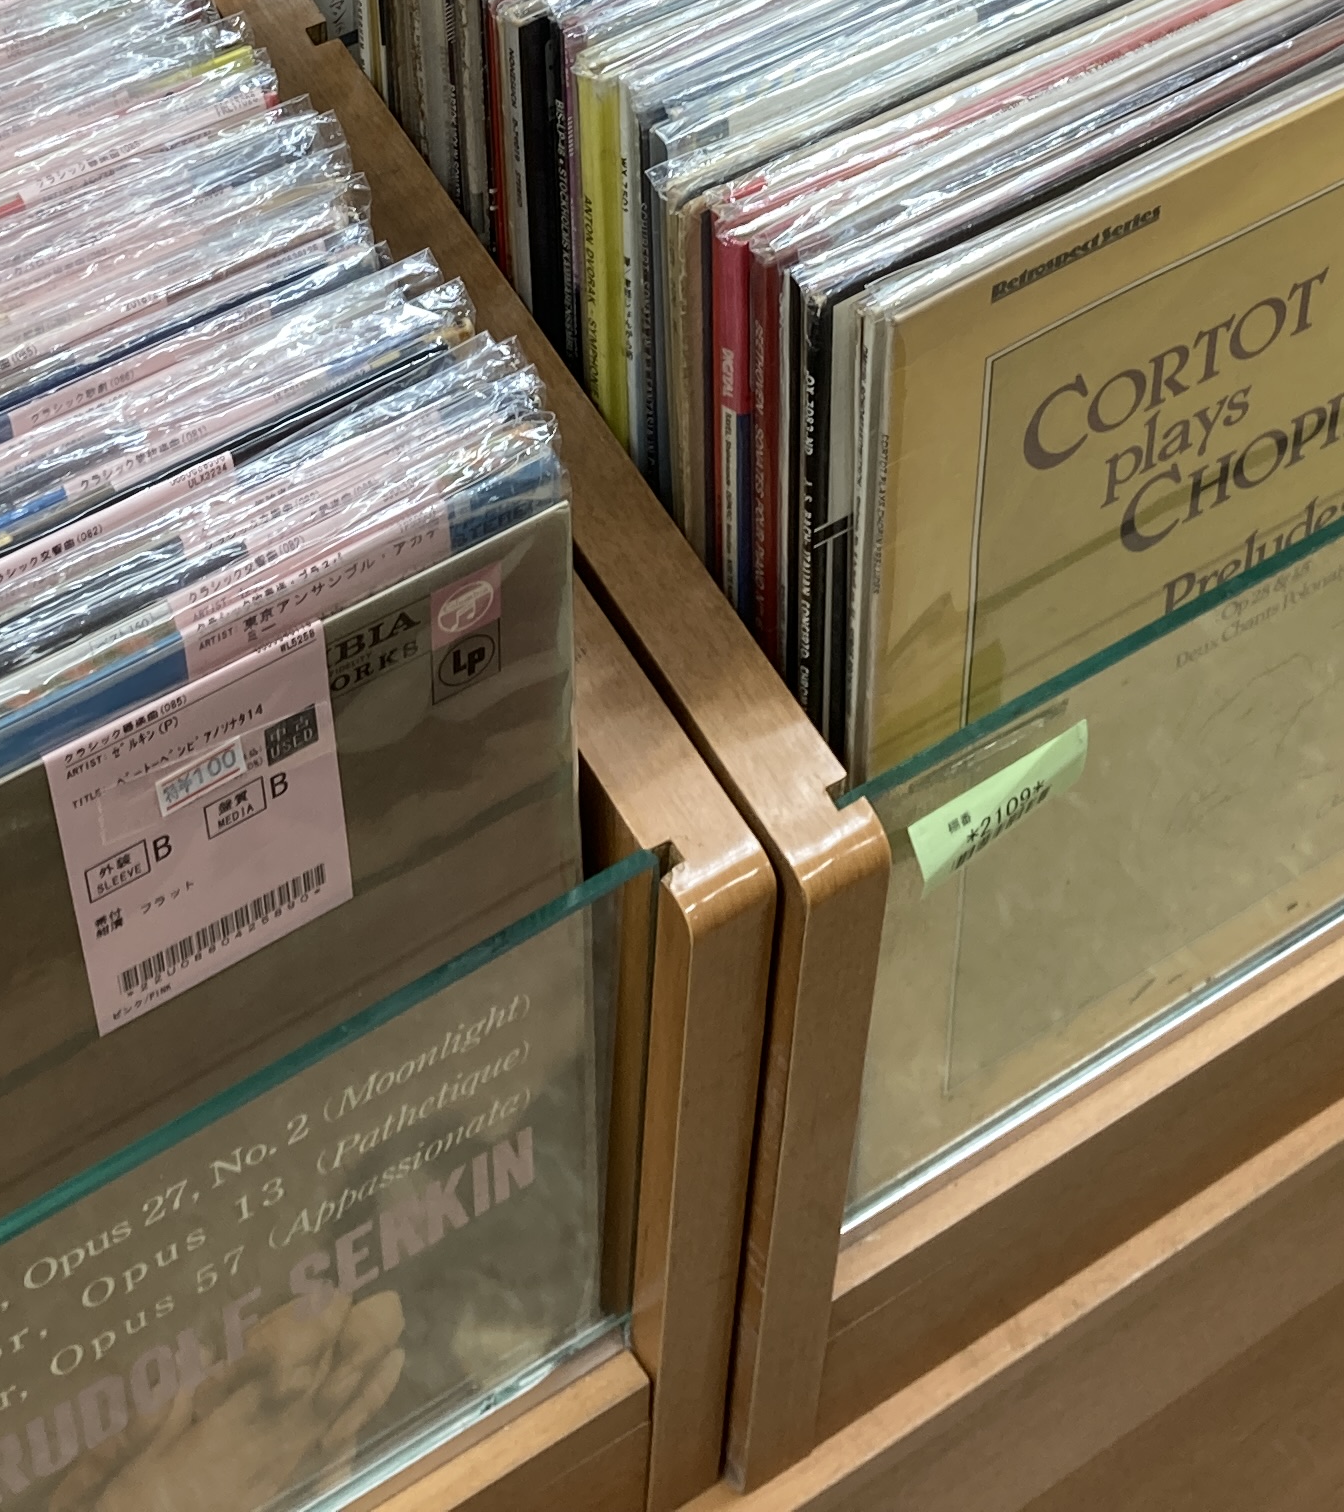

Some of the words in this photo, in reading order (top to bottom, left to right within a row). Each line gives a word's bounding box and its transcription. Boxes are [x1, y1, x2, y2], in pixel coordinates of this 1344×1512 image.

[584, 194, 595, 246] ANTON
[586, 248, 596, 305] DVORAK
[721, 348, 734, 398] DIGITAL
[1023, 266, 1331, 471] CORTOT
[879, 434, 890, 474] CORTOT
[1101, 384, 1253, 508] plays
[878, 477, 887, 507] PLAYS
[452, 646, 486, 677] LP
[63, 694, 188, 764] クラシック器楽曲(085)
[270, 716, 311, 742] 中古
[270, 728, 314, 761] USED
[217, 803, 255, 830] MEDIA
[270, 771, 289, 800] B
[97, 864, 143, 896] SLEEVE
[152, 834, 173, 862] B
[22, 1218, 133, 1290] Opus
[140, 1179, 201, 1229] 27,
[208, 1141, 278, 1189] No.
[286, 1114, 311, 1146] 2
[322, 994, 532, 1123] (Moonlight)
[81, 1226, 207, 1310] Opus
[237, 1177, 286, 1224] 13
[316, 1039, 532, 1175] (Pathetique)
[50, 1293, 175, 1378] Opus
[196, 1245, 246, 1295] 57
[268, 1087, 532, 1250] (Appassionata)
[288, 1126, 534, 1323] SERKIN
